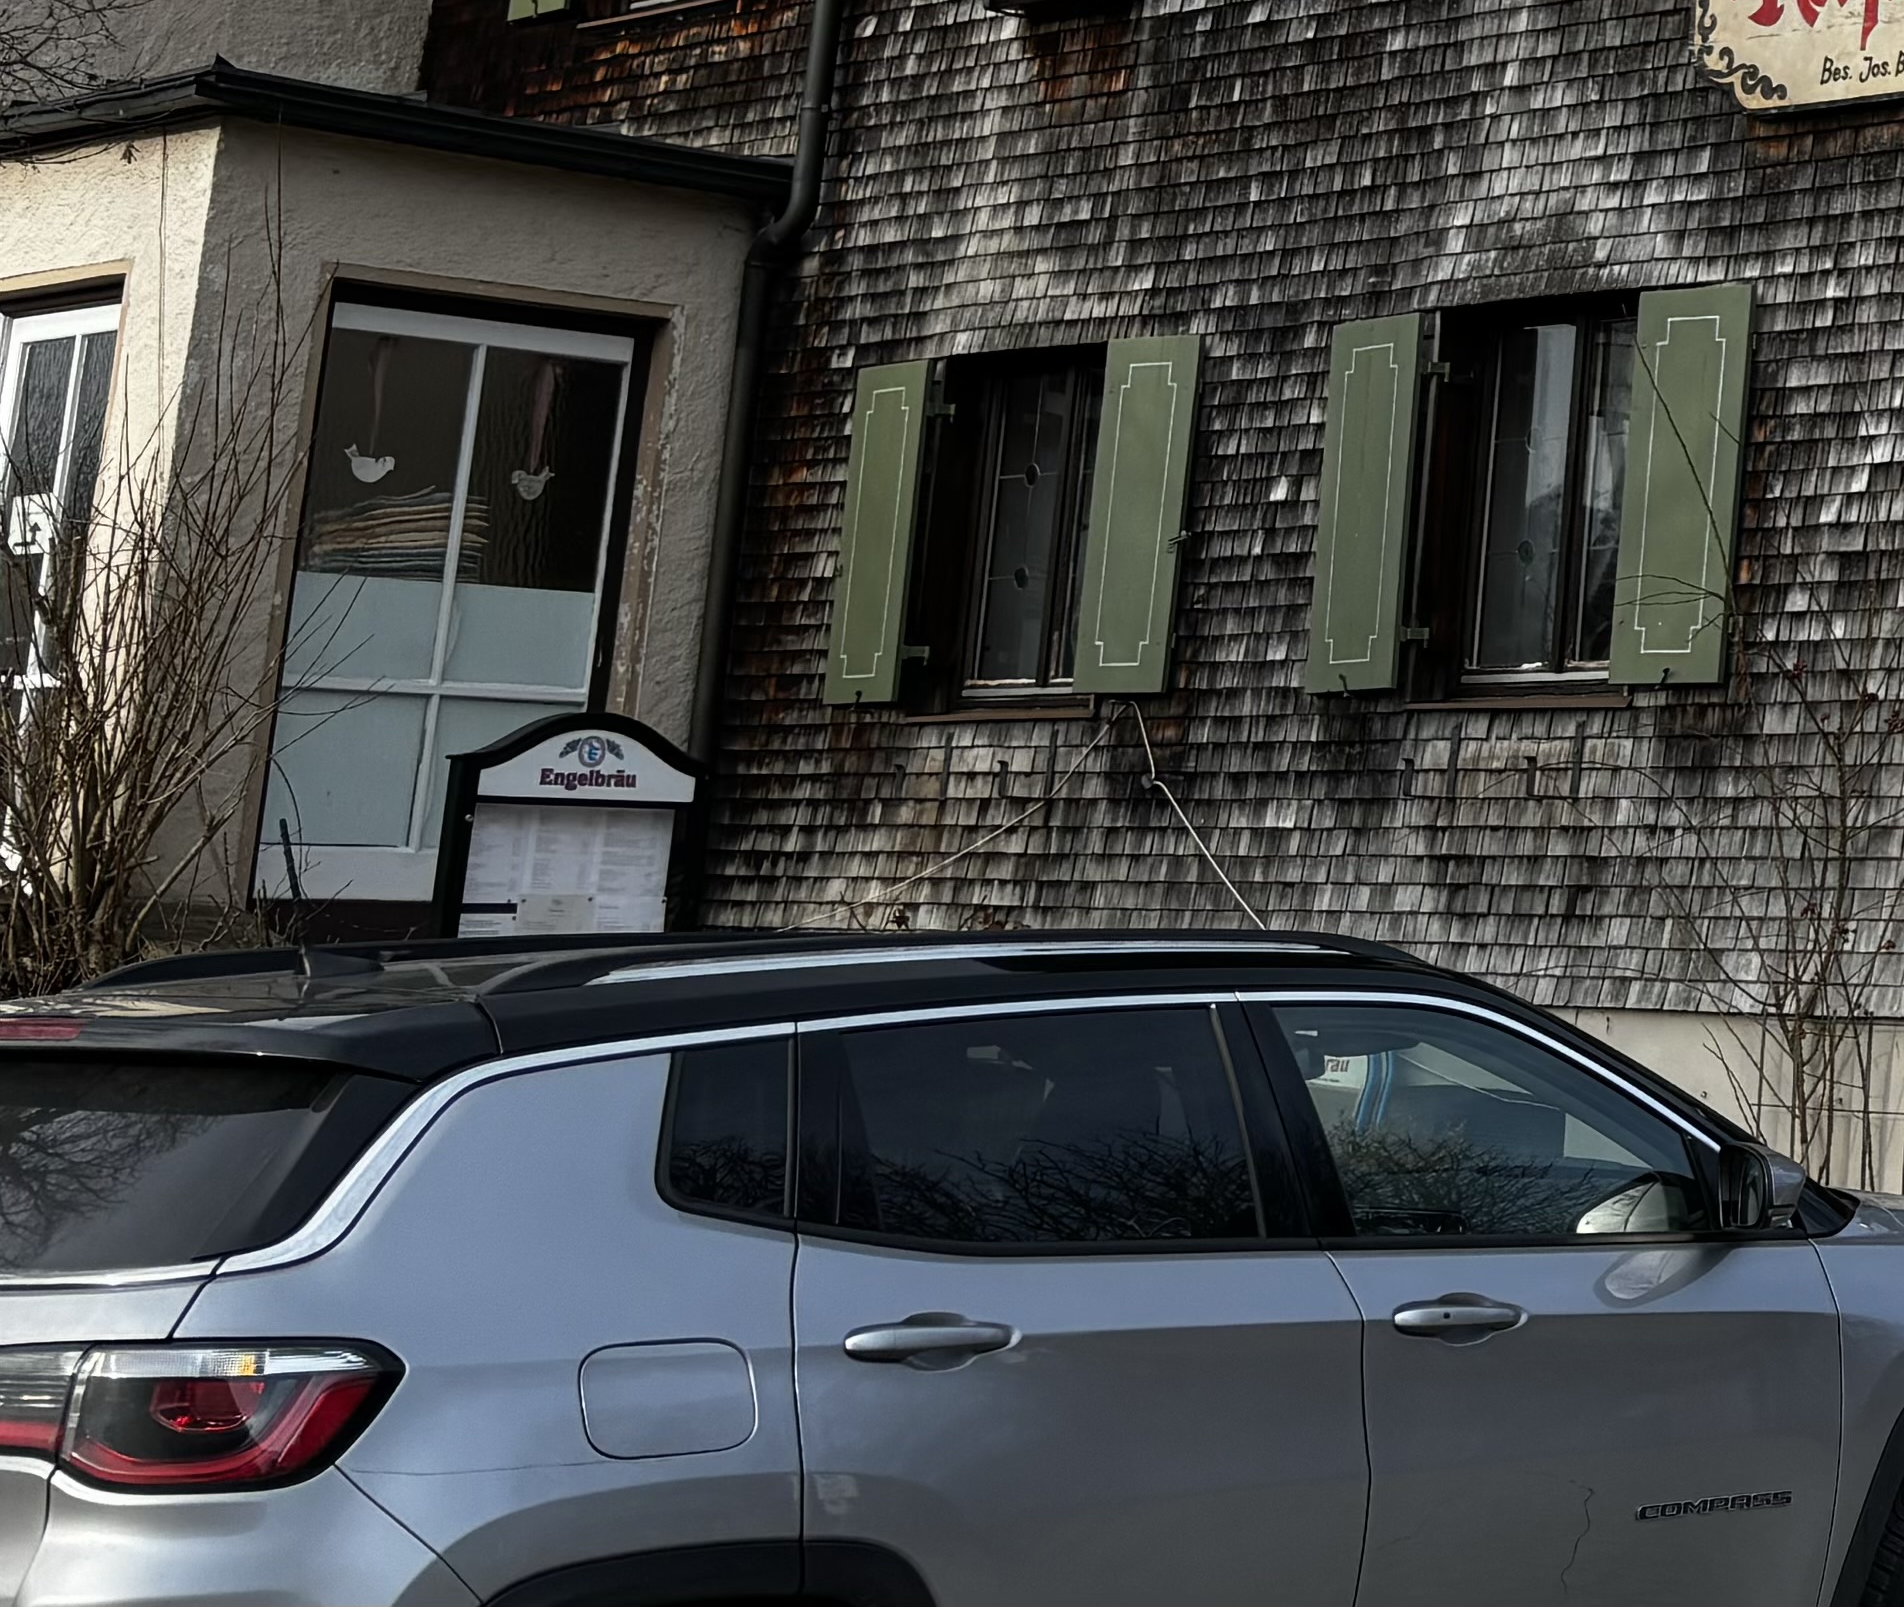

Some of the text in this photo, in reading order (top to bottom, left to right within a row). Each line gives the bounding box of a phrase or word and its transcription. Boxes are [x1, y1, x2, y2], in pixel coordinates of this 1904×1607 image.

[1820, 55, 1852, 85] Bes.
[1859, 56, 1891, 83] Jos.
[539, 768, 636, 791] Engelbräu
[1636, 1490, 1793, 1521] COMPASS
